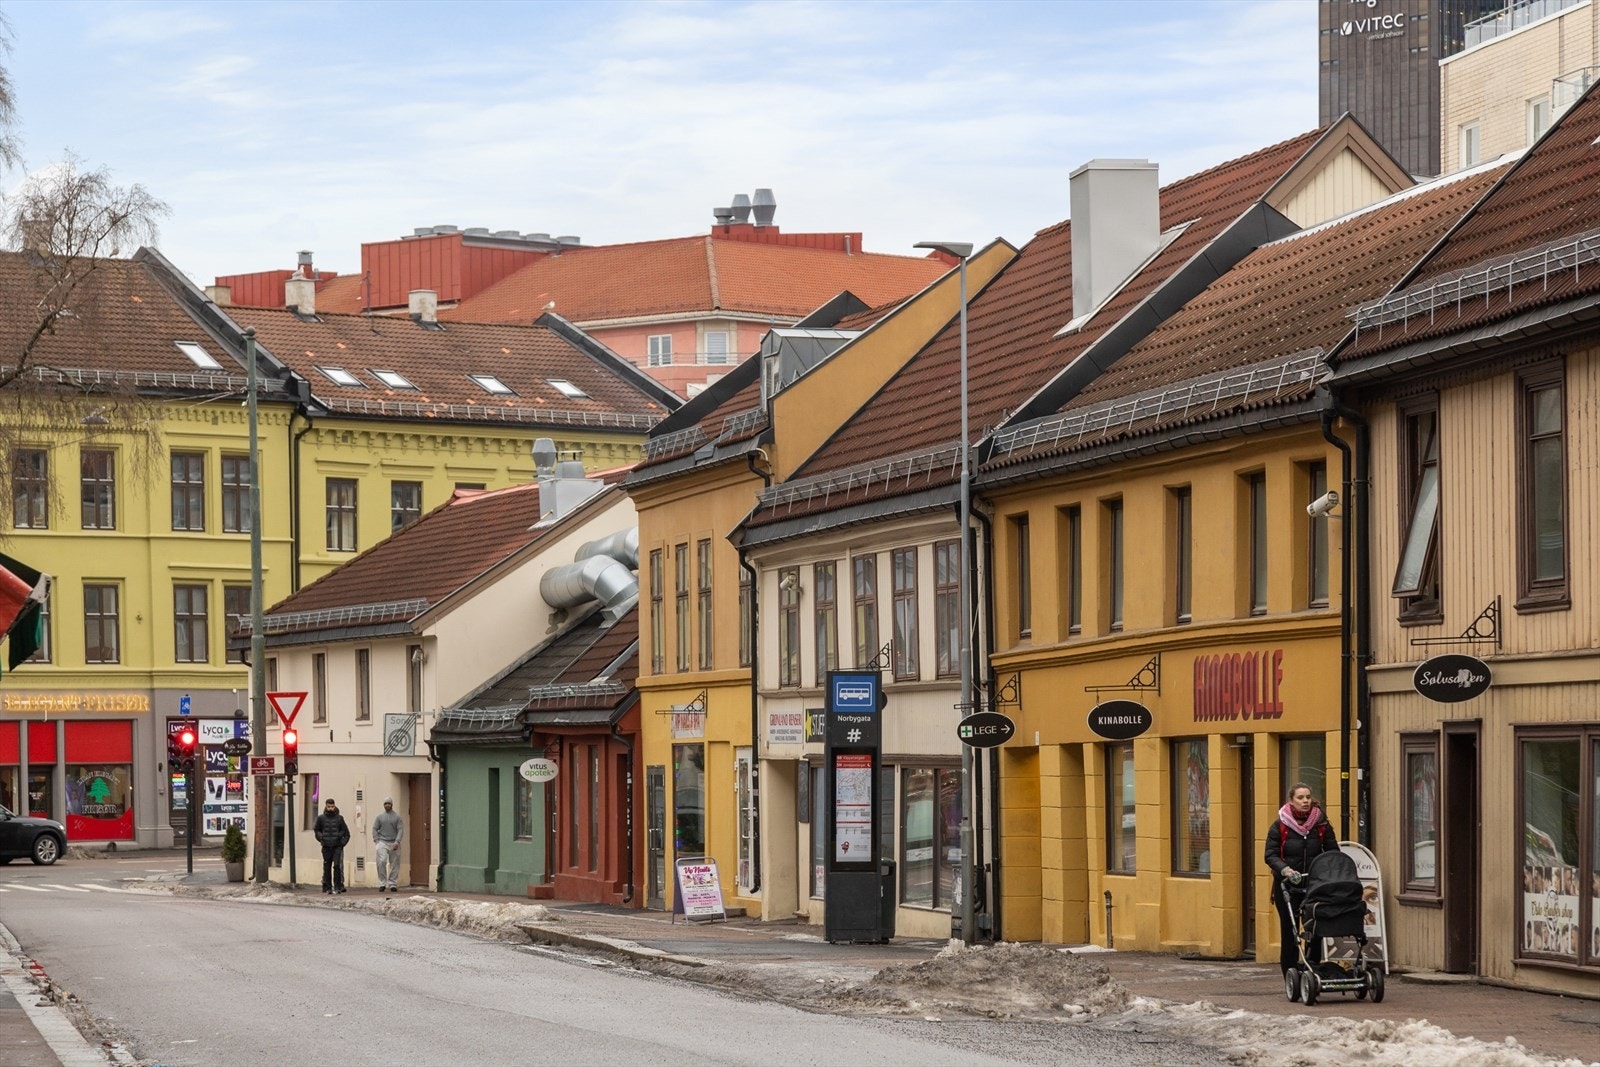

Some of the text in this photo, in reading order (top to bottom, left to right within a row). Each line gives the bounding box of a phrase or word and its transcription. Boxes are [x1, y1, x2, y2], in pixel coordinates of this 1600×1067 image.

[1193, 649, 1283, 722] KINABOLLE
[84, 694, 150, 711] FRISØR
[837, 715, 871, 723] Norbygata
[1098, 715, 1142, 725] KINABOLLE
[202, 725, 223, 735] Lyca
[974, 726, 997, 735] LEGE
